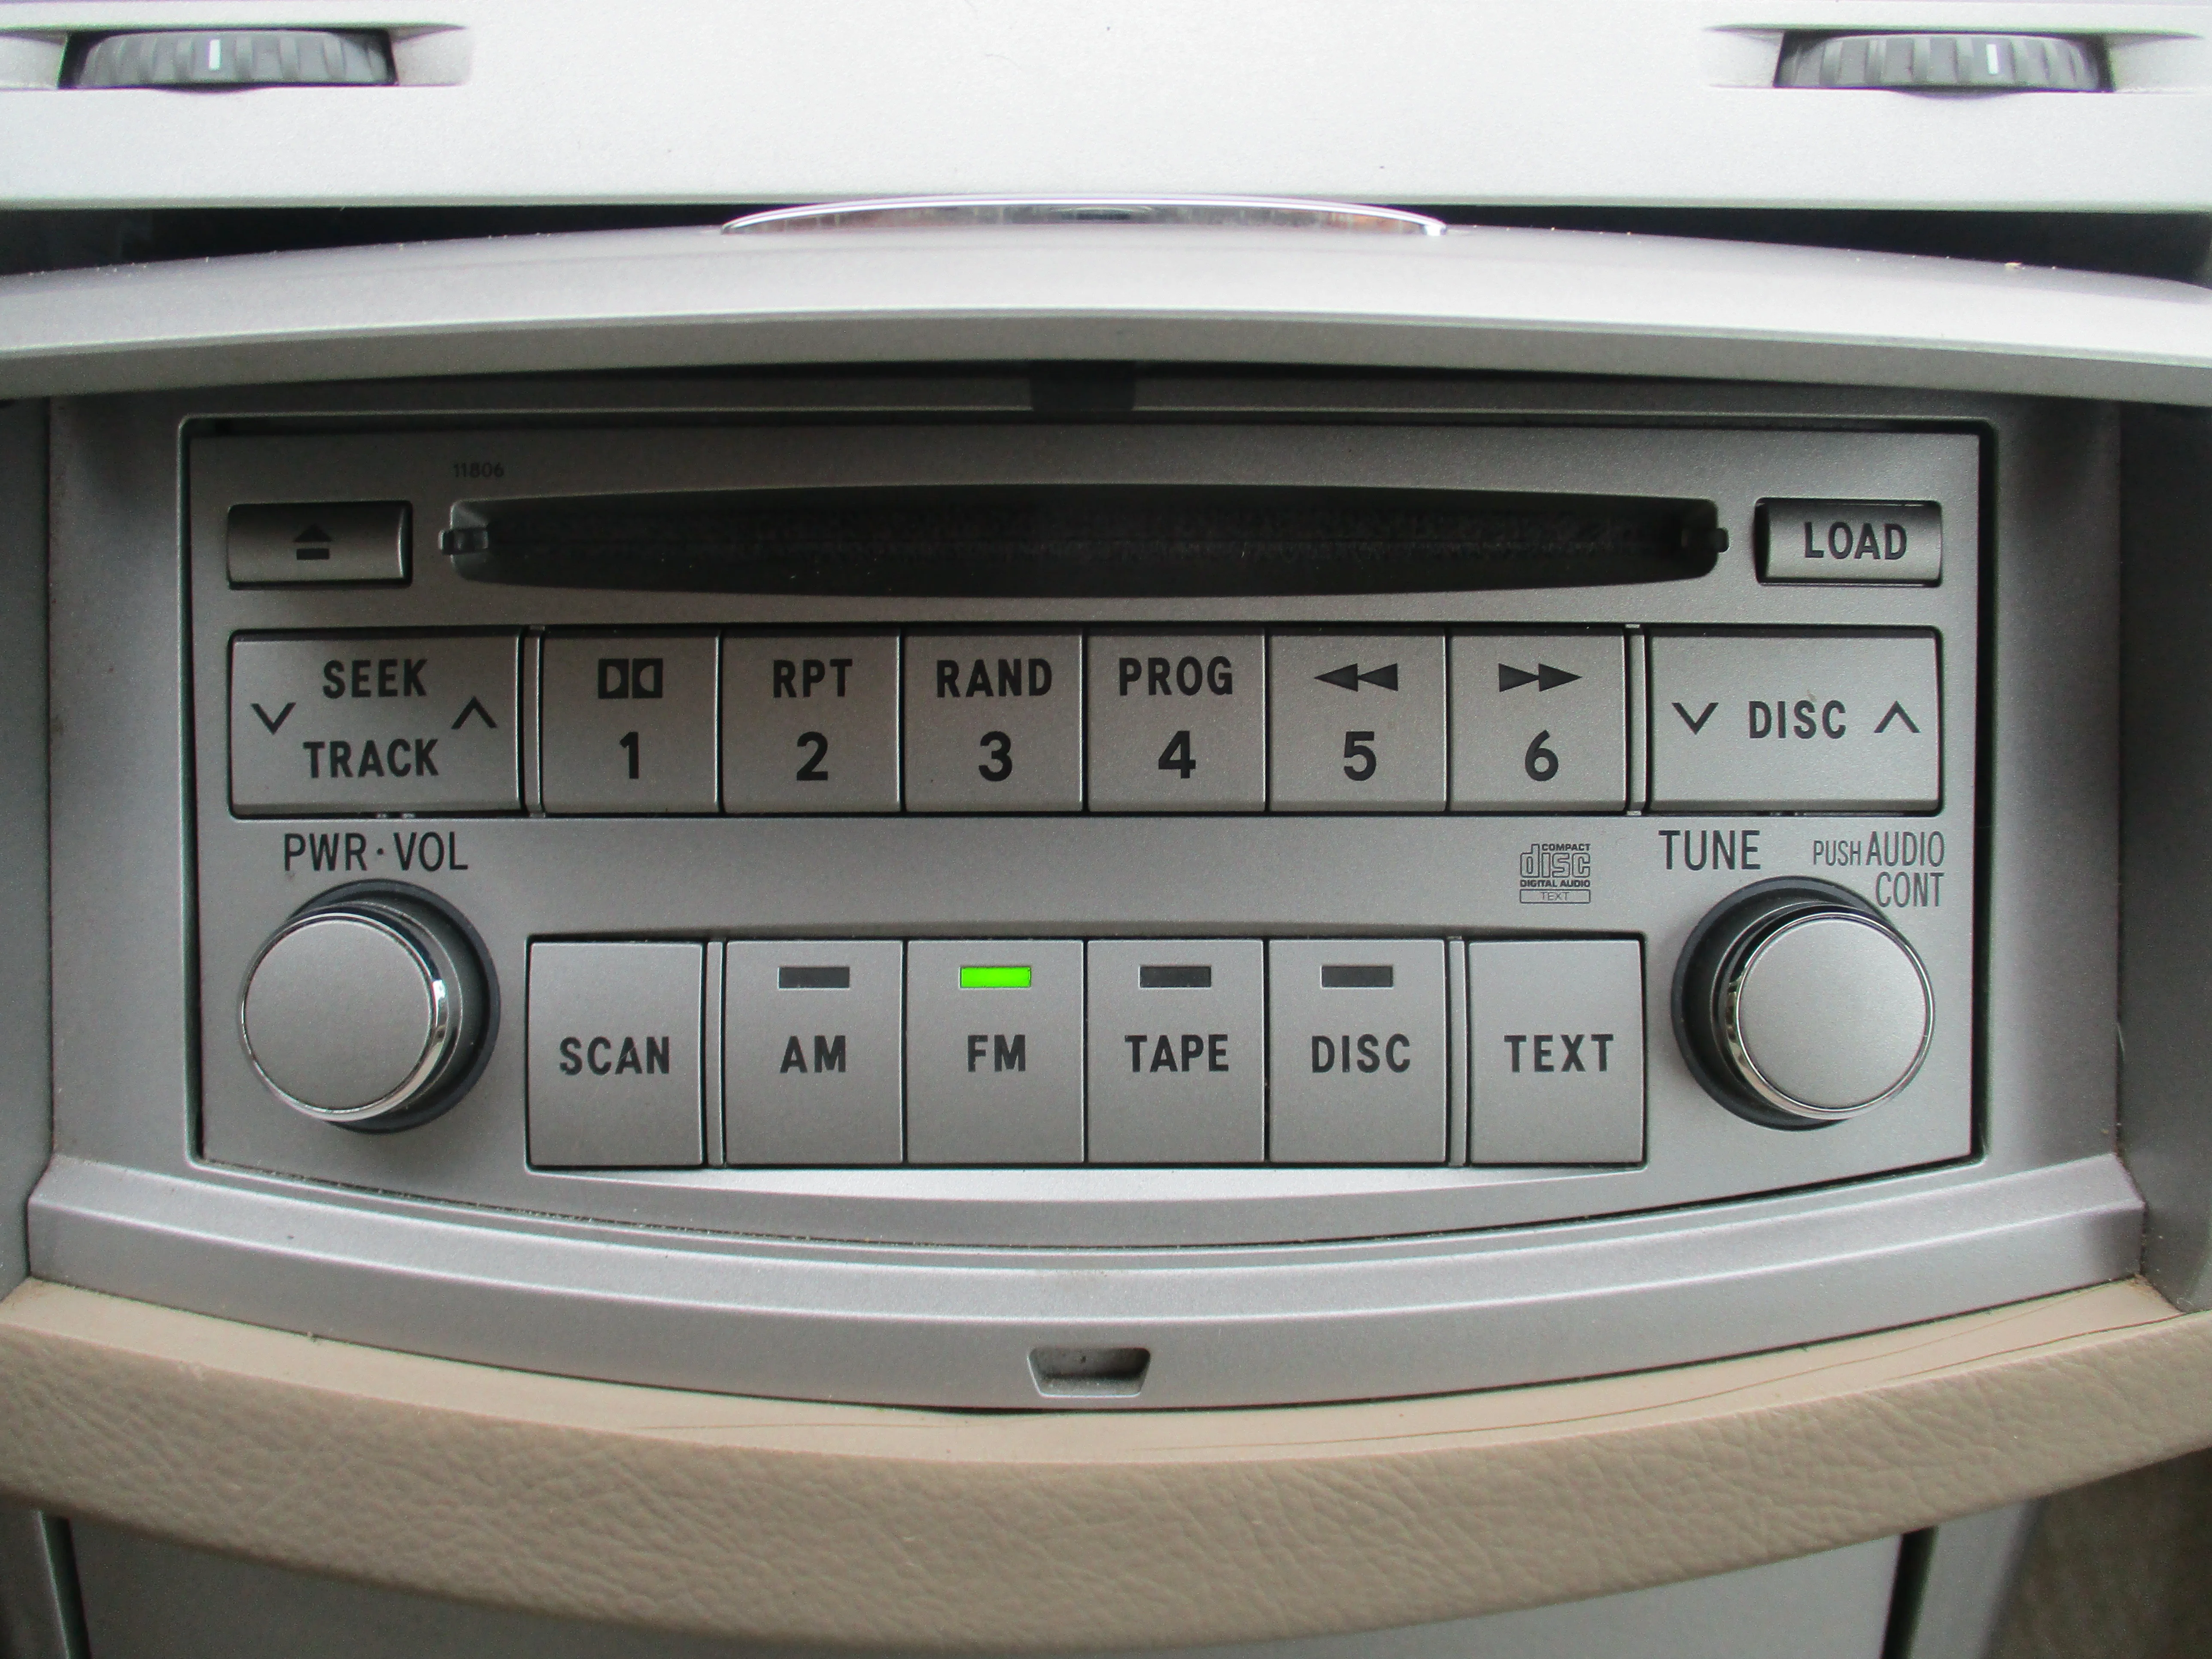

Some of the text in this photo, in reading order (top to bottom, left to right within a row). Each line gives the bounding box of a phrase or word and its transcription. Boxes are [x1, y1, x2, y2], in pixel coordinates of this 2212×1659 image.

[453, 461, 505, 478] 11806
[1805, 520, 1907, 560] LOAD
[322, 658, 428, 699] SEEK
[773, 658, 853, 698] RPT
[937, 658, 1052, 698] RAND
[1119, 656, 1233, 696] PROG
[1749, 699, 1846, 739] DISC
[303, 738, 439, 779] TRACK
[620, 731, 639, 779] 1
[796, 731, 828, 781] 2
[979, 731, 1012, 782] 3
[1158, 730, 1196, 780] 4
[1344, 731, 1377, 781] 5
[1525, 730, 1559, 782] 6
[1659, 830, 1761, 871] TUNE
[1813, 831, 1945, 867] PUSH AUDIO
[1540, 892, 1569, 900] TEXT
[1875, 871, 1945, 908] CONT
[560, 1036, 669, 1076] SCAN
[780, 1035, 846, 1074] AM
[967, 1034, 1025, 1072] FM
[1125, 1034, 1229, 1072] TAPE
[1312, 1033, 1410, 1073] DISC
[1504, 1034, 1613, 1072] TEXT
